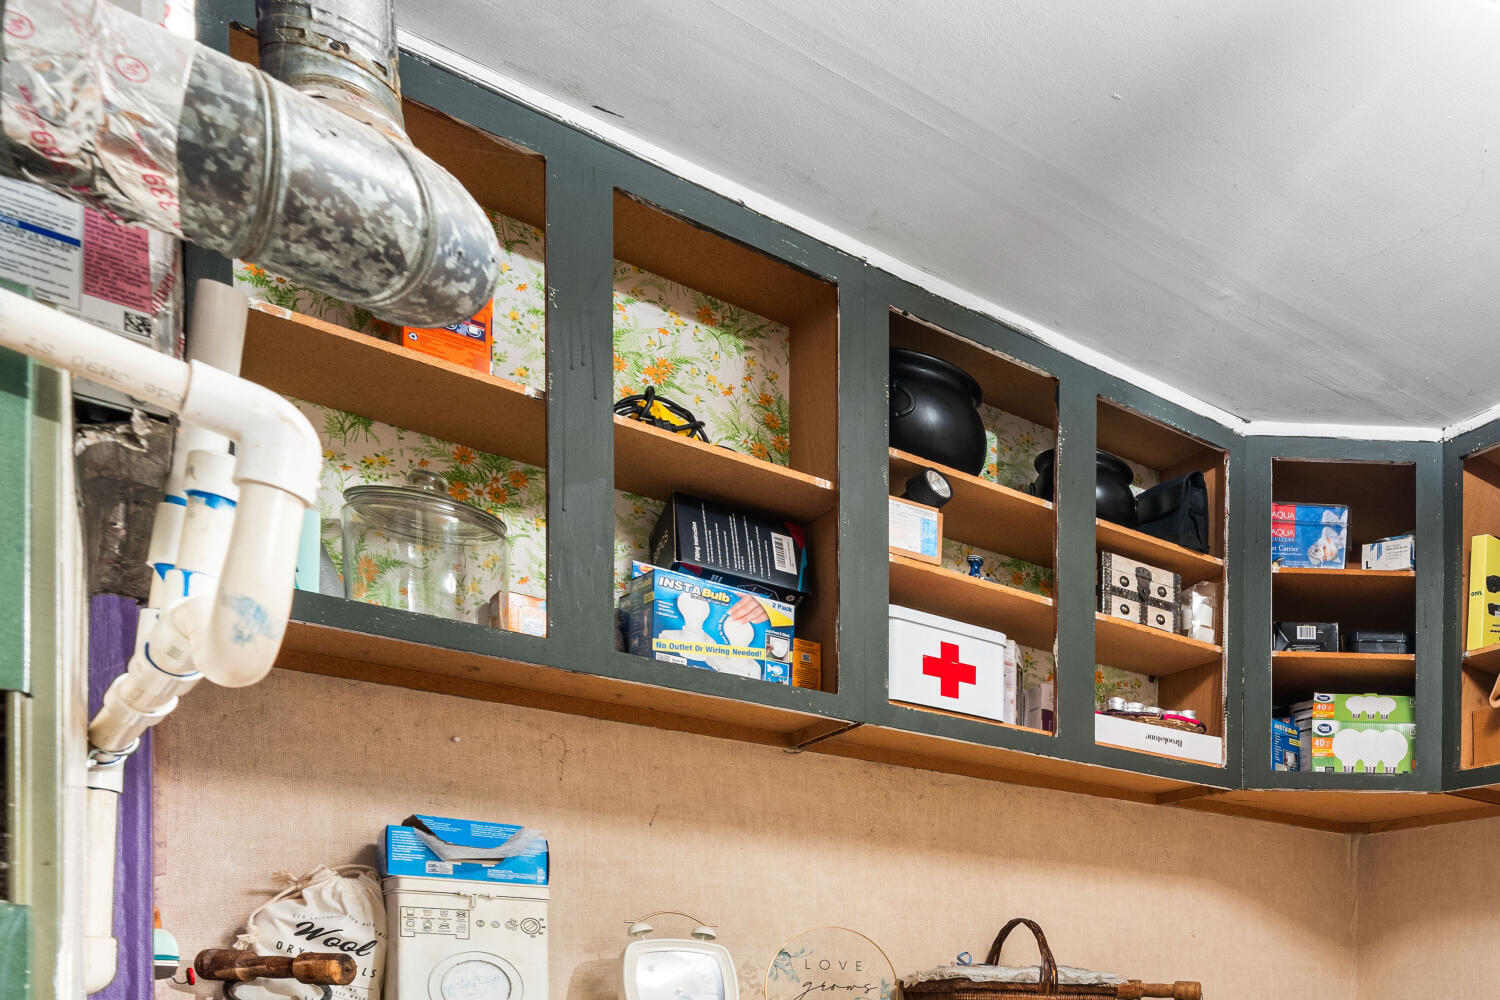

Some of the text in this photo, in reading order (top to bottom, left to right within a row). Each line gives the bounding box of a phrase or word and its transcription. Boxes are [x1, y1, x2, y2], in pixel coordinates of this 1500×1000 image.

[1365, 560, 1372, 569] L
[658, 576, 731, 603] INSTABulb
[777, 604, 793, 613] Pack
[656, 641, 762, 658] No Outlet Or Wiring Needed!
[1314, 738, 1325, 747] 40
[294, 921, 378, 957] Wool
[804, 958, 863, 972] LOVE
